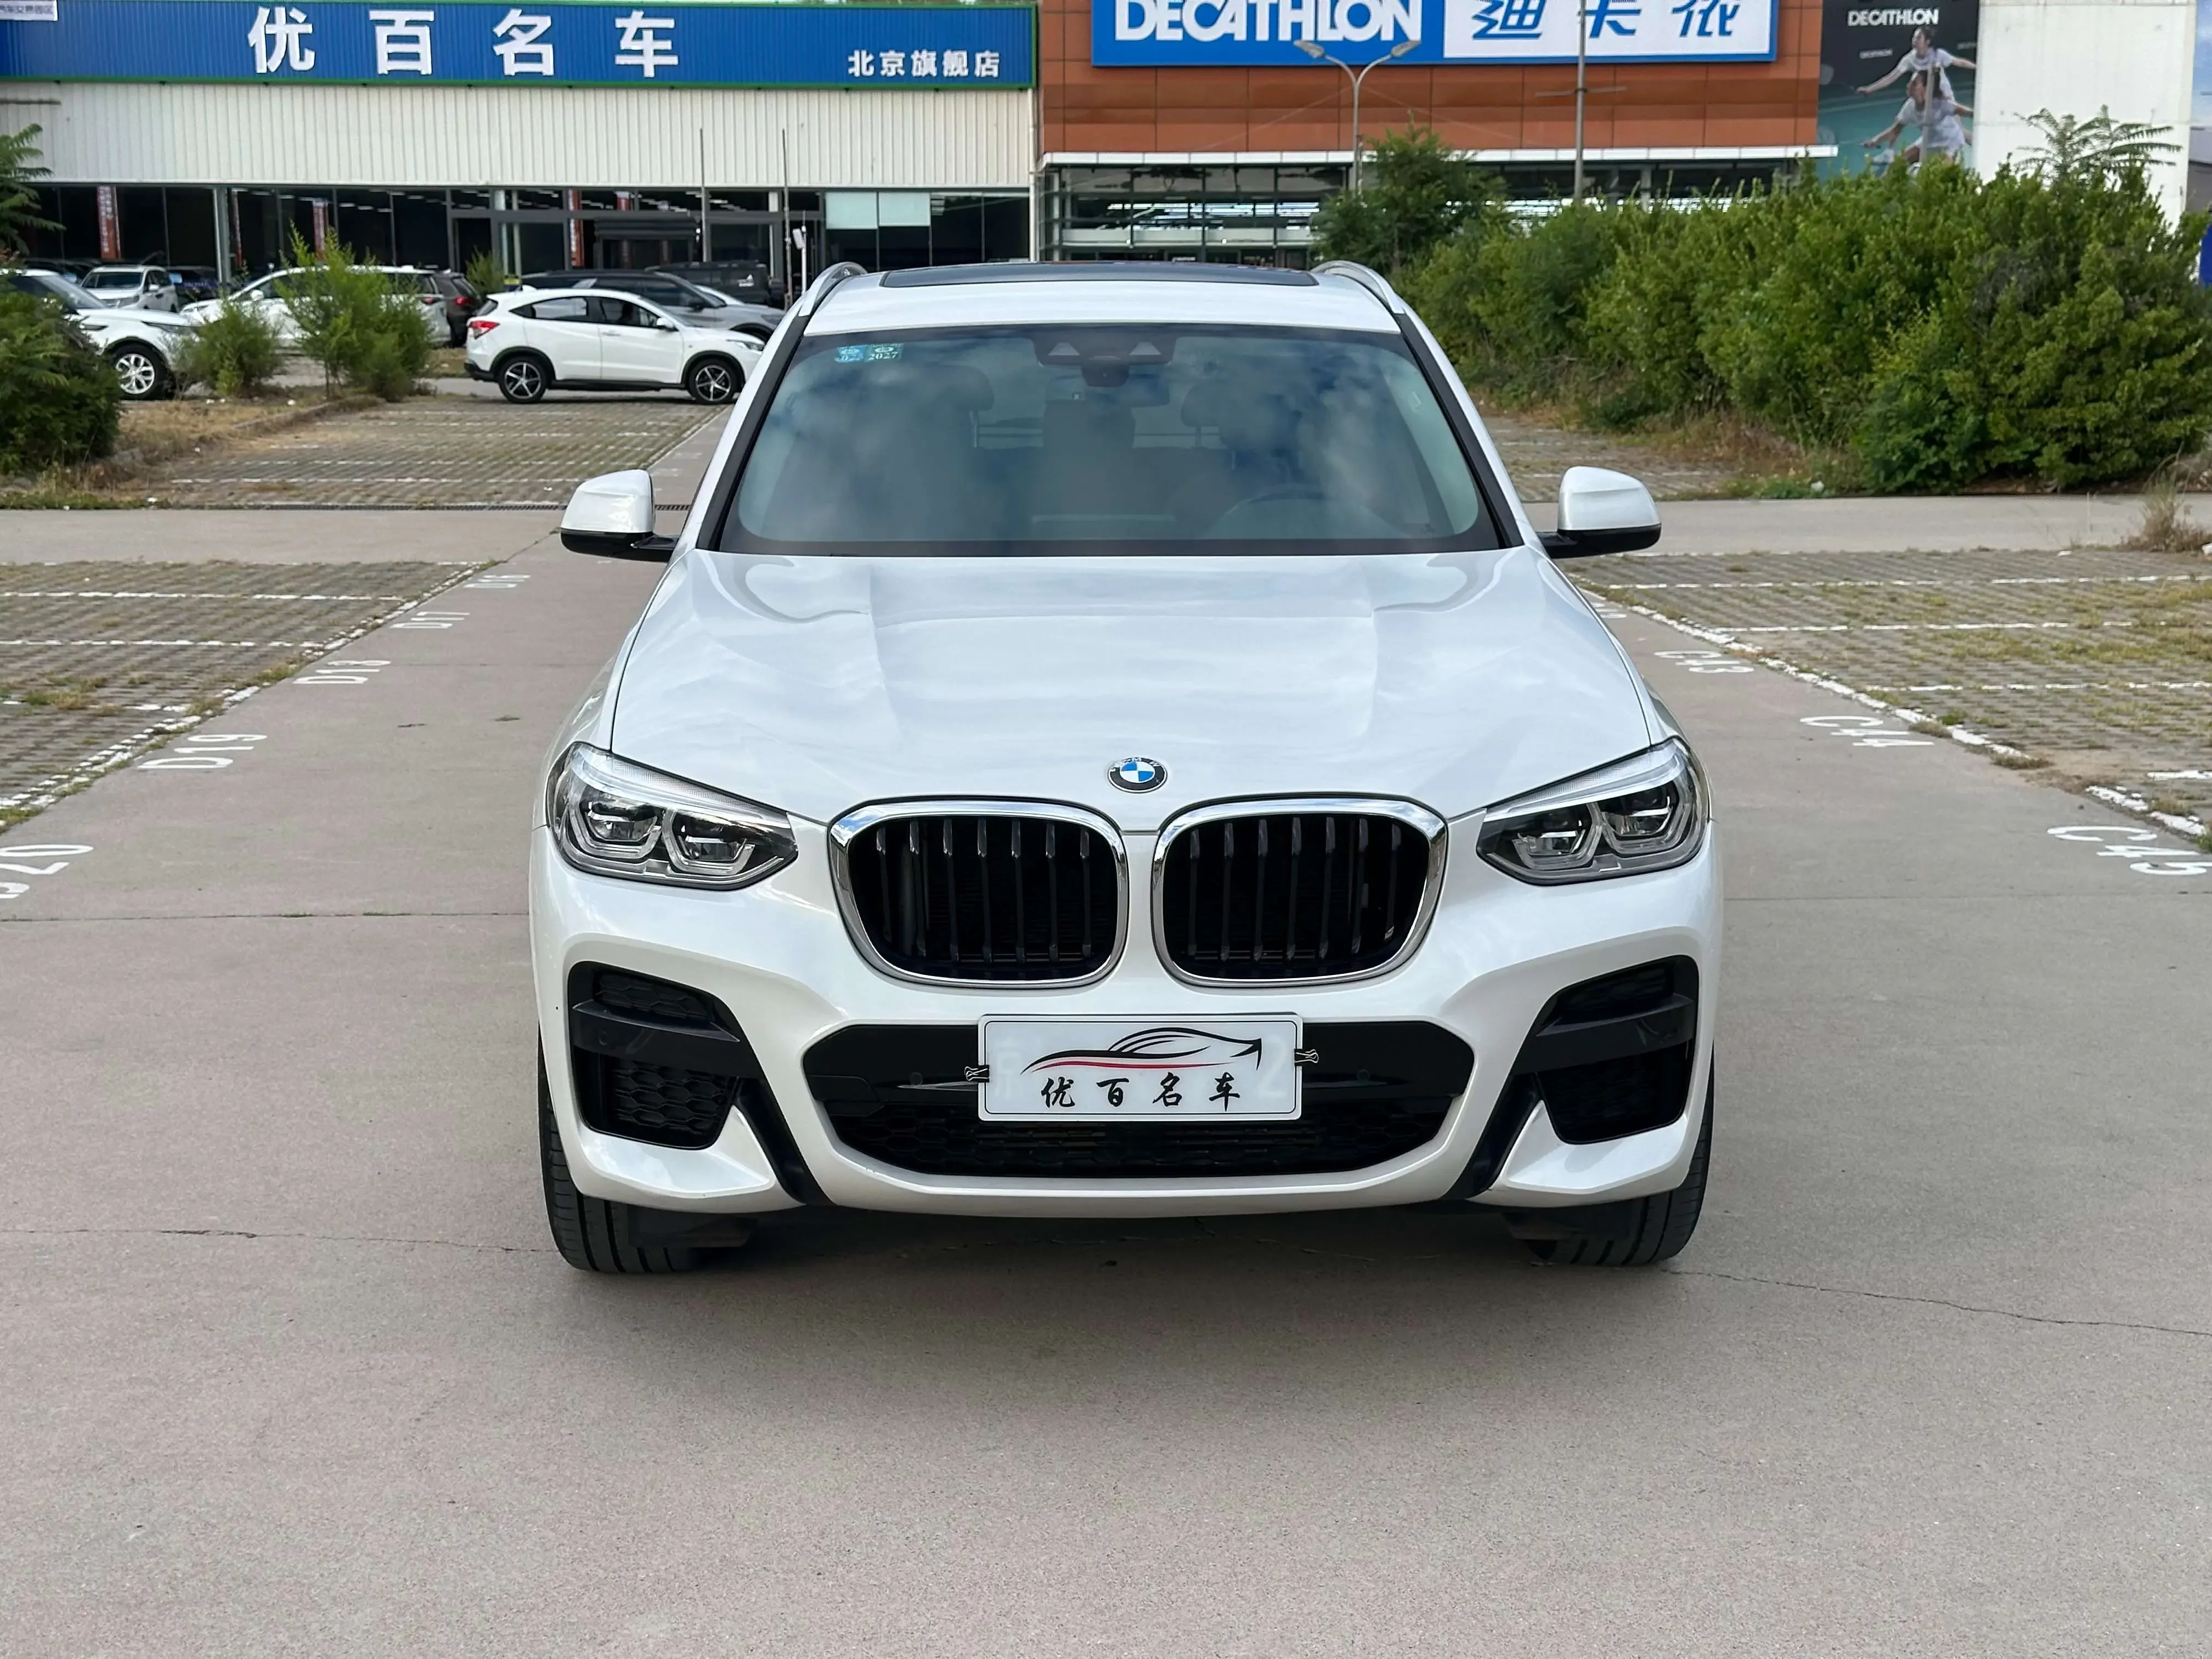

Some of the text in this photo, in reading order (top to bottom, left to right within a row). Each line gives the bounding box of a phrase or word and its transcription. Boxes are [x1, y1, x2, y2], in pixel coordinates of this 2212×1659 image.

[1115, 0, 1421, 42] DECATHLON
[1847, 8, 1939, 26] DECATHLON
[247, 7, 679, 78] 优百名车
[848, 49, 1000, 78] 北京旗舰店
[1799, 715, 1935, 747] C44
[138, 734, 268, 769] D19
[0, 844, 94, 899] 20
[1040, 1071, 1240, 1113] 优百名车
